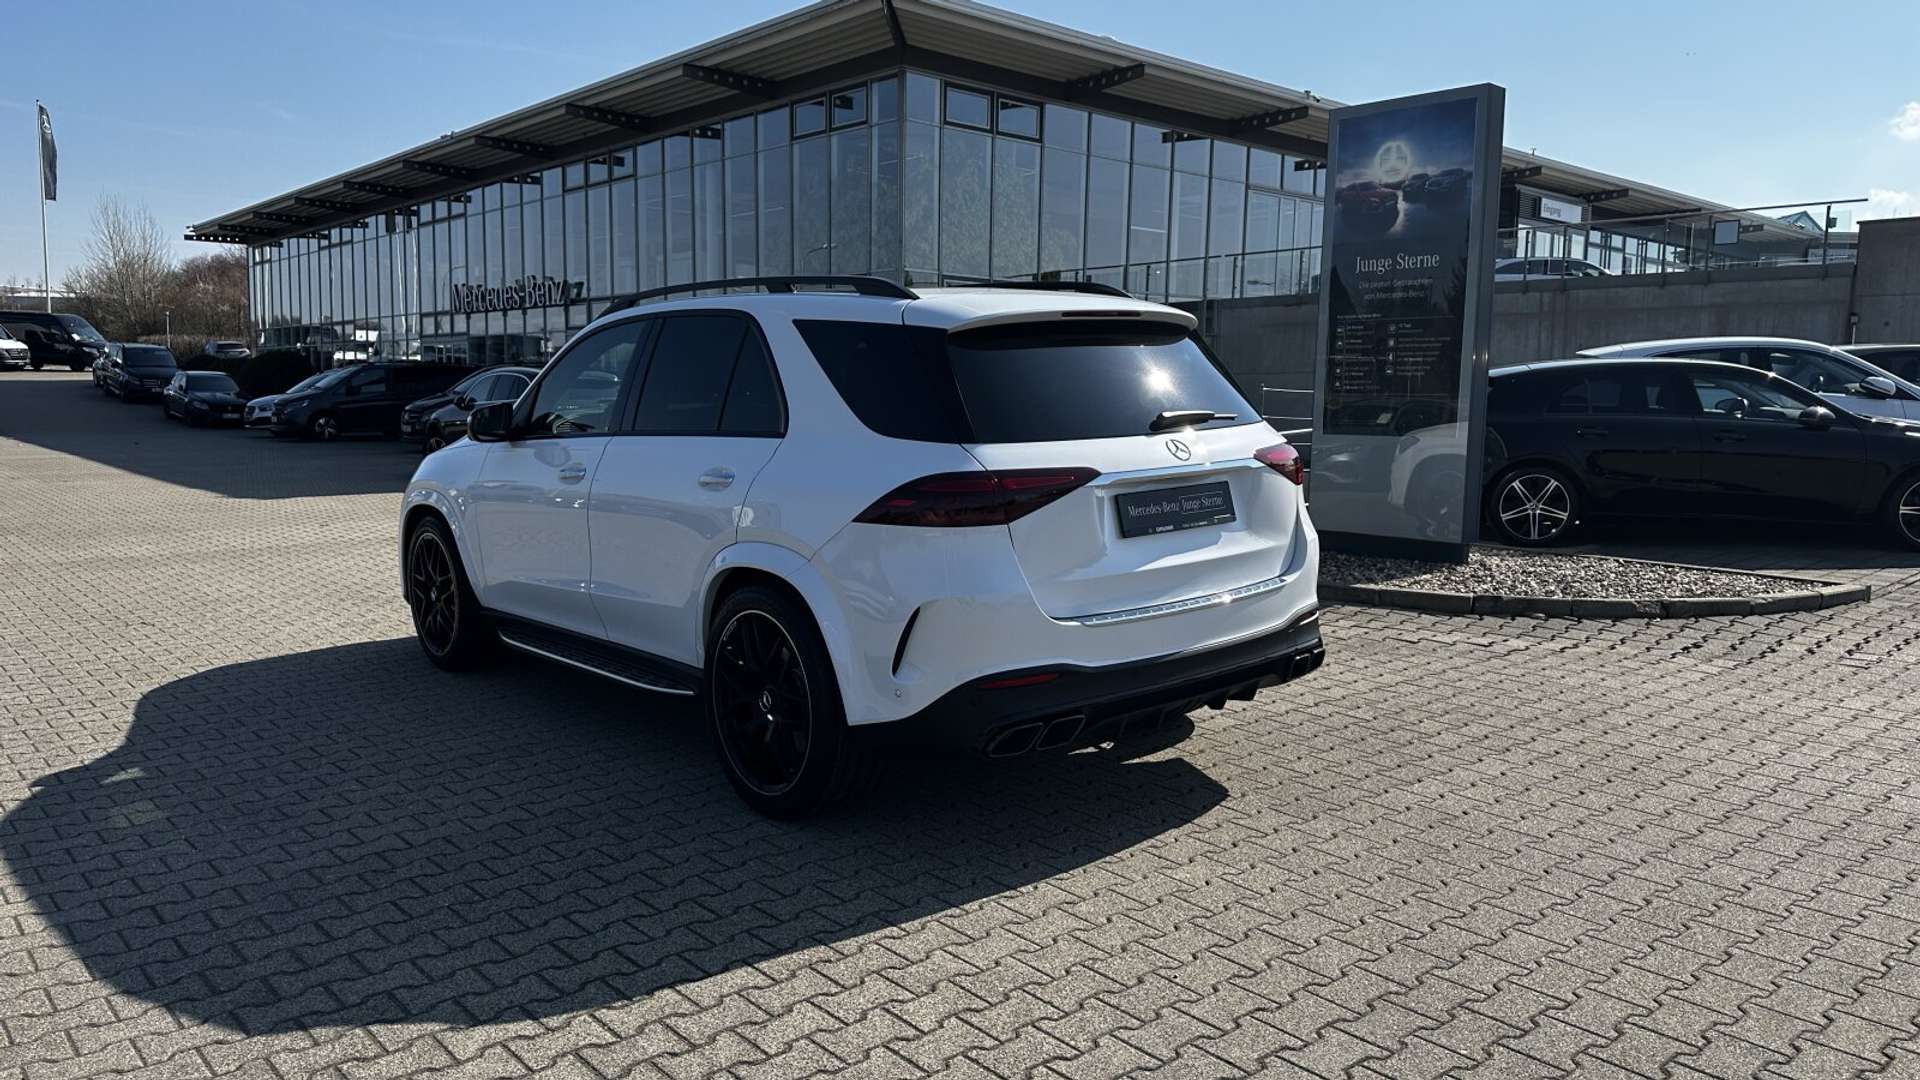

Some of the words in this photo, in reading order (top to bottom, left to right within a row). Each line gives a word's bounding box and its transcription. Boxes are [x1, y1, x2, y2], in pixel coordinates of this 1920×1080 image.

[1355, 256, 1393, 275] Junge
[1396, 252, 1440, 270] Sterne
[452, 274, 565, 313] Mercedes-Benz
[1128, 501, 1180, 518] Mercedes-Benz
[1181, 498, 1200, 512] Junge
[1201, 495, 1224, 508] Sterne
